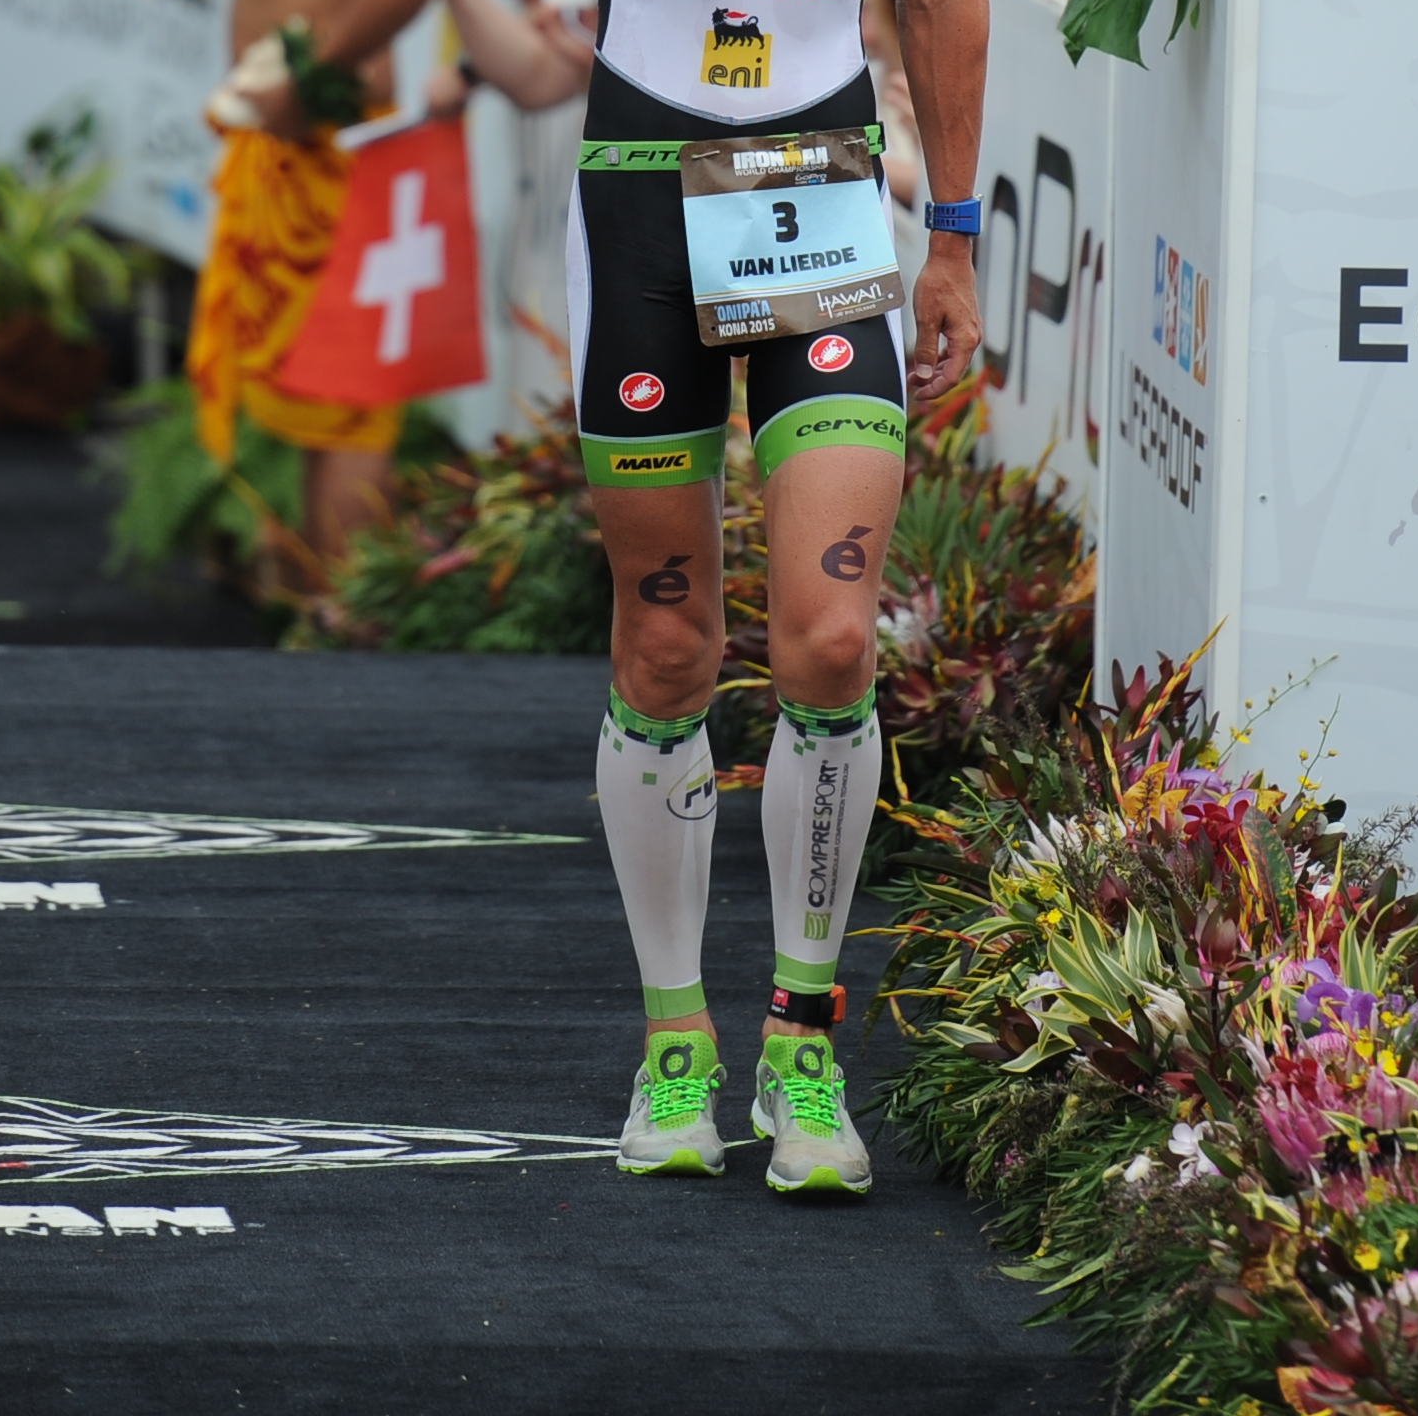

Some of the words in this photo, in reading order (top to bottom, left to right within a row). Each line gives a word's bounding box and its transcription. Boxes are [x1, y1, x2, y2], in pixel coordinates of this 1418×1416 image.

[708, 56, 762, 89] eni
[733, 142, 829, 170] IRONMAN
[734, 167, 766, 177] WORLD
[771, 201, 800, 243] 3
[729, 256, 775, 278] VAN
[779, 246, 857, 274] LIERDE
[718, 321, 749, 338] KONA
[749, 318, 776, 334] 2015
[1120, 349, 1205, 515] LIFEPROOF
[615, 453, 688, 471] MAVIC
